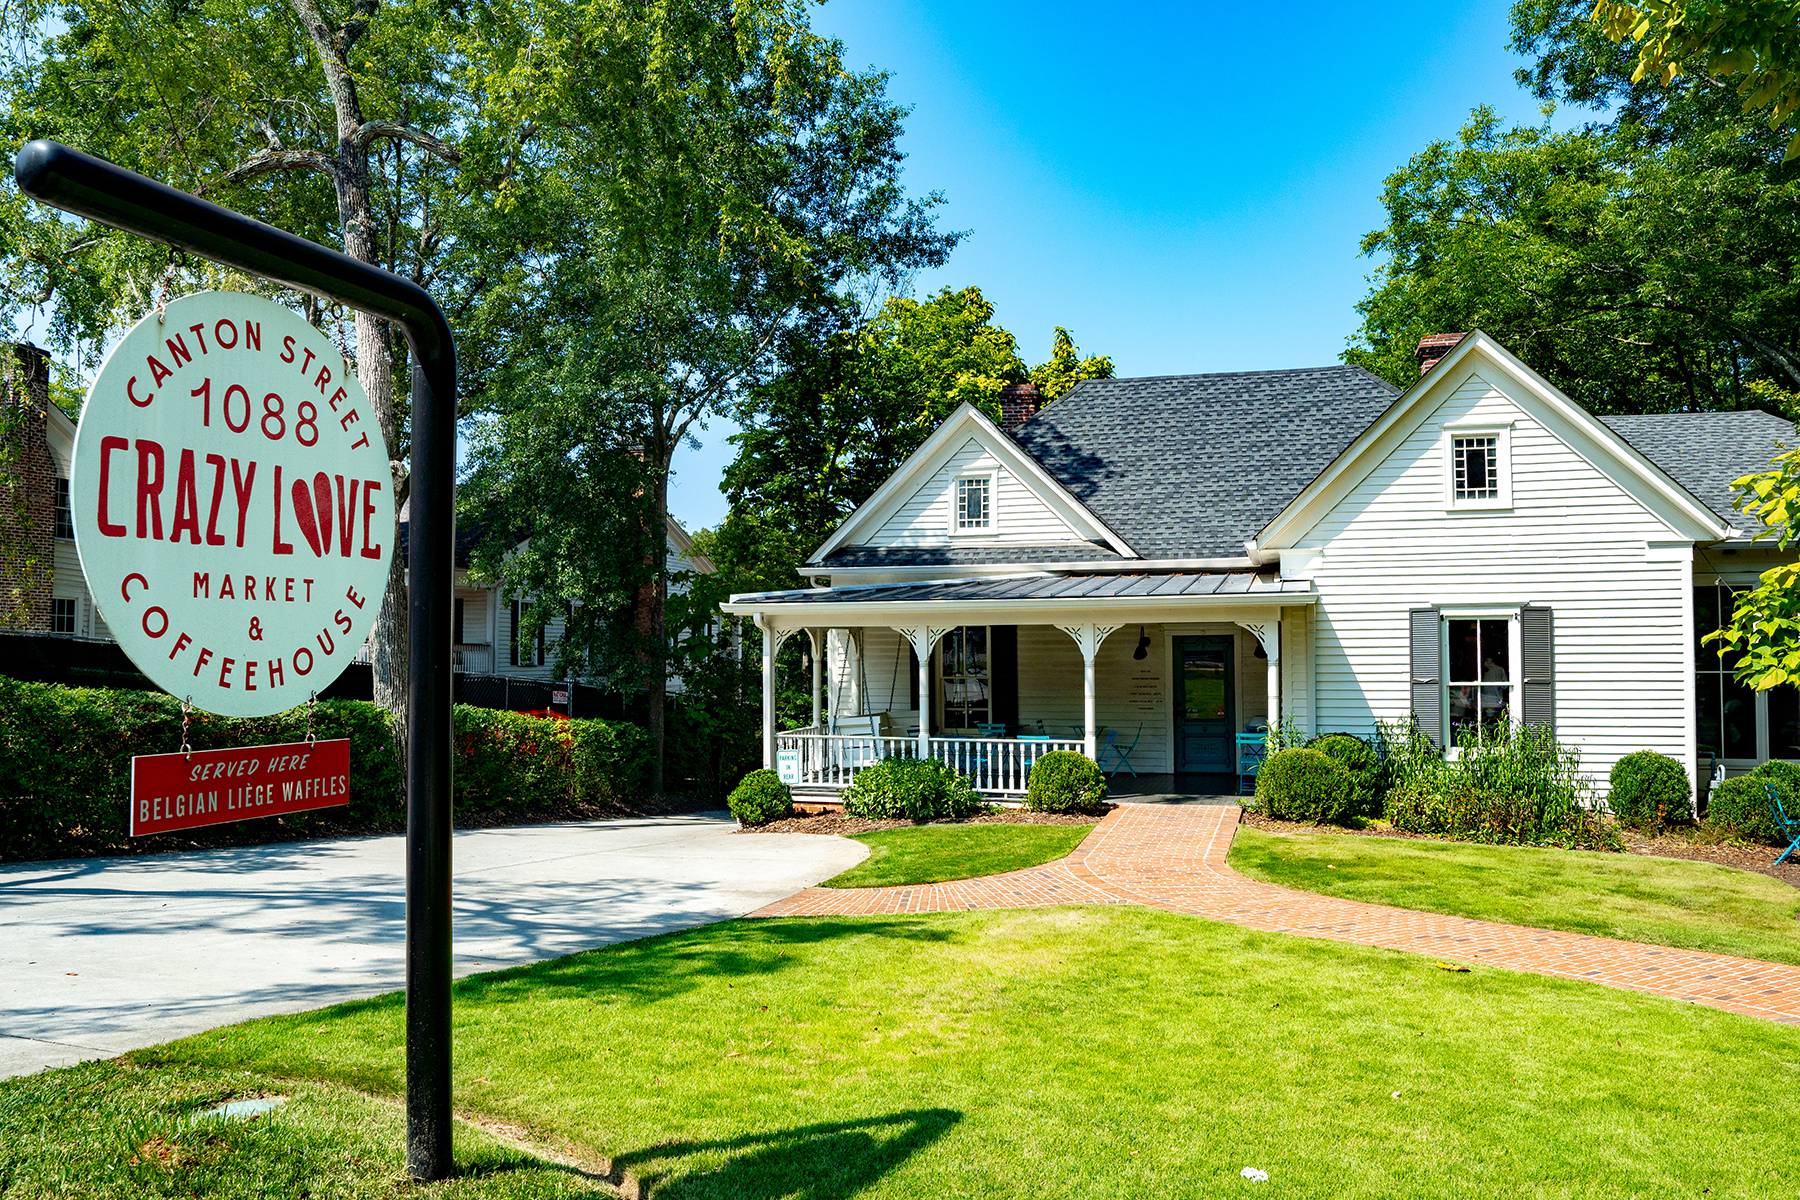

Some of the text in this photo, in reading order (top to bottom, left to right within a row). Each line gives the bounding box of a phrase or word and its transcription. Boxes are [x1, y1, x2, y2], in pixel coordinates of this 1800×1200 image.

[127, 318, 370, 450] CANTON STREET
[190, 377, 319, 447] 1088
[97, 435, 257, 548] CRAZY
[193, 571, 314, 603] MARKET
[121, 572, 366, 691] COFFEEHOUSE
[248, 616, 264, 642] &
[189, 754, 311, 782] SERVED HERE
[139, 774, 347, 823] BELGIAN LIÈGE WAFFLES
